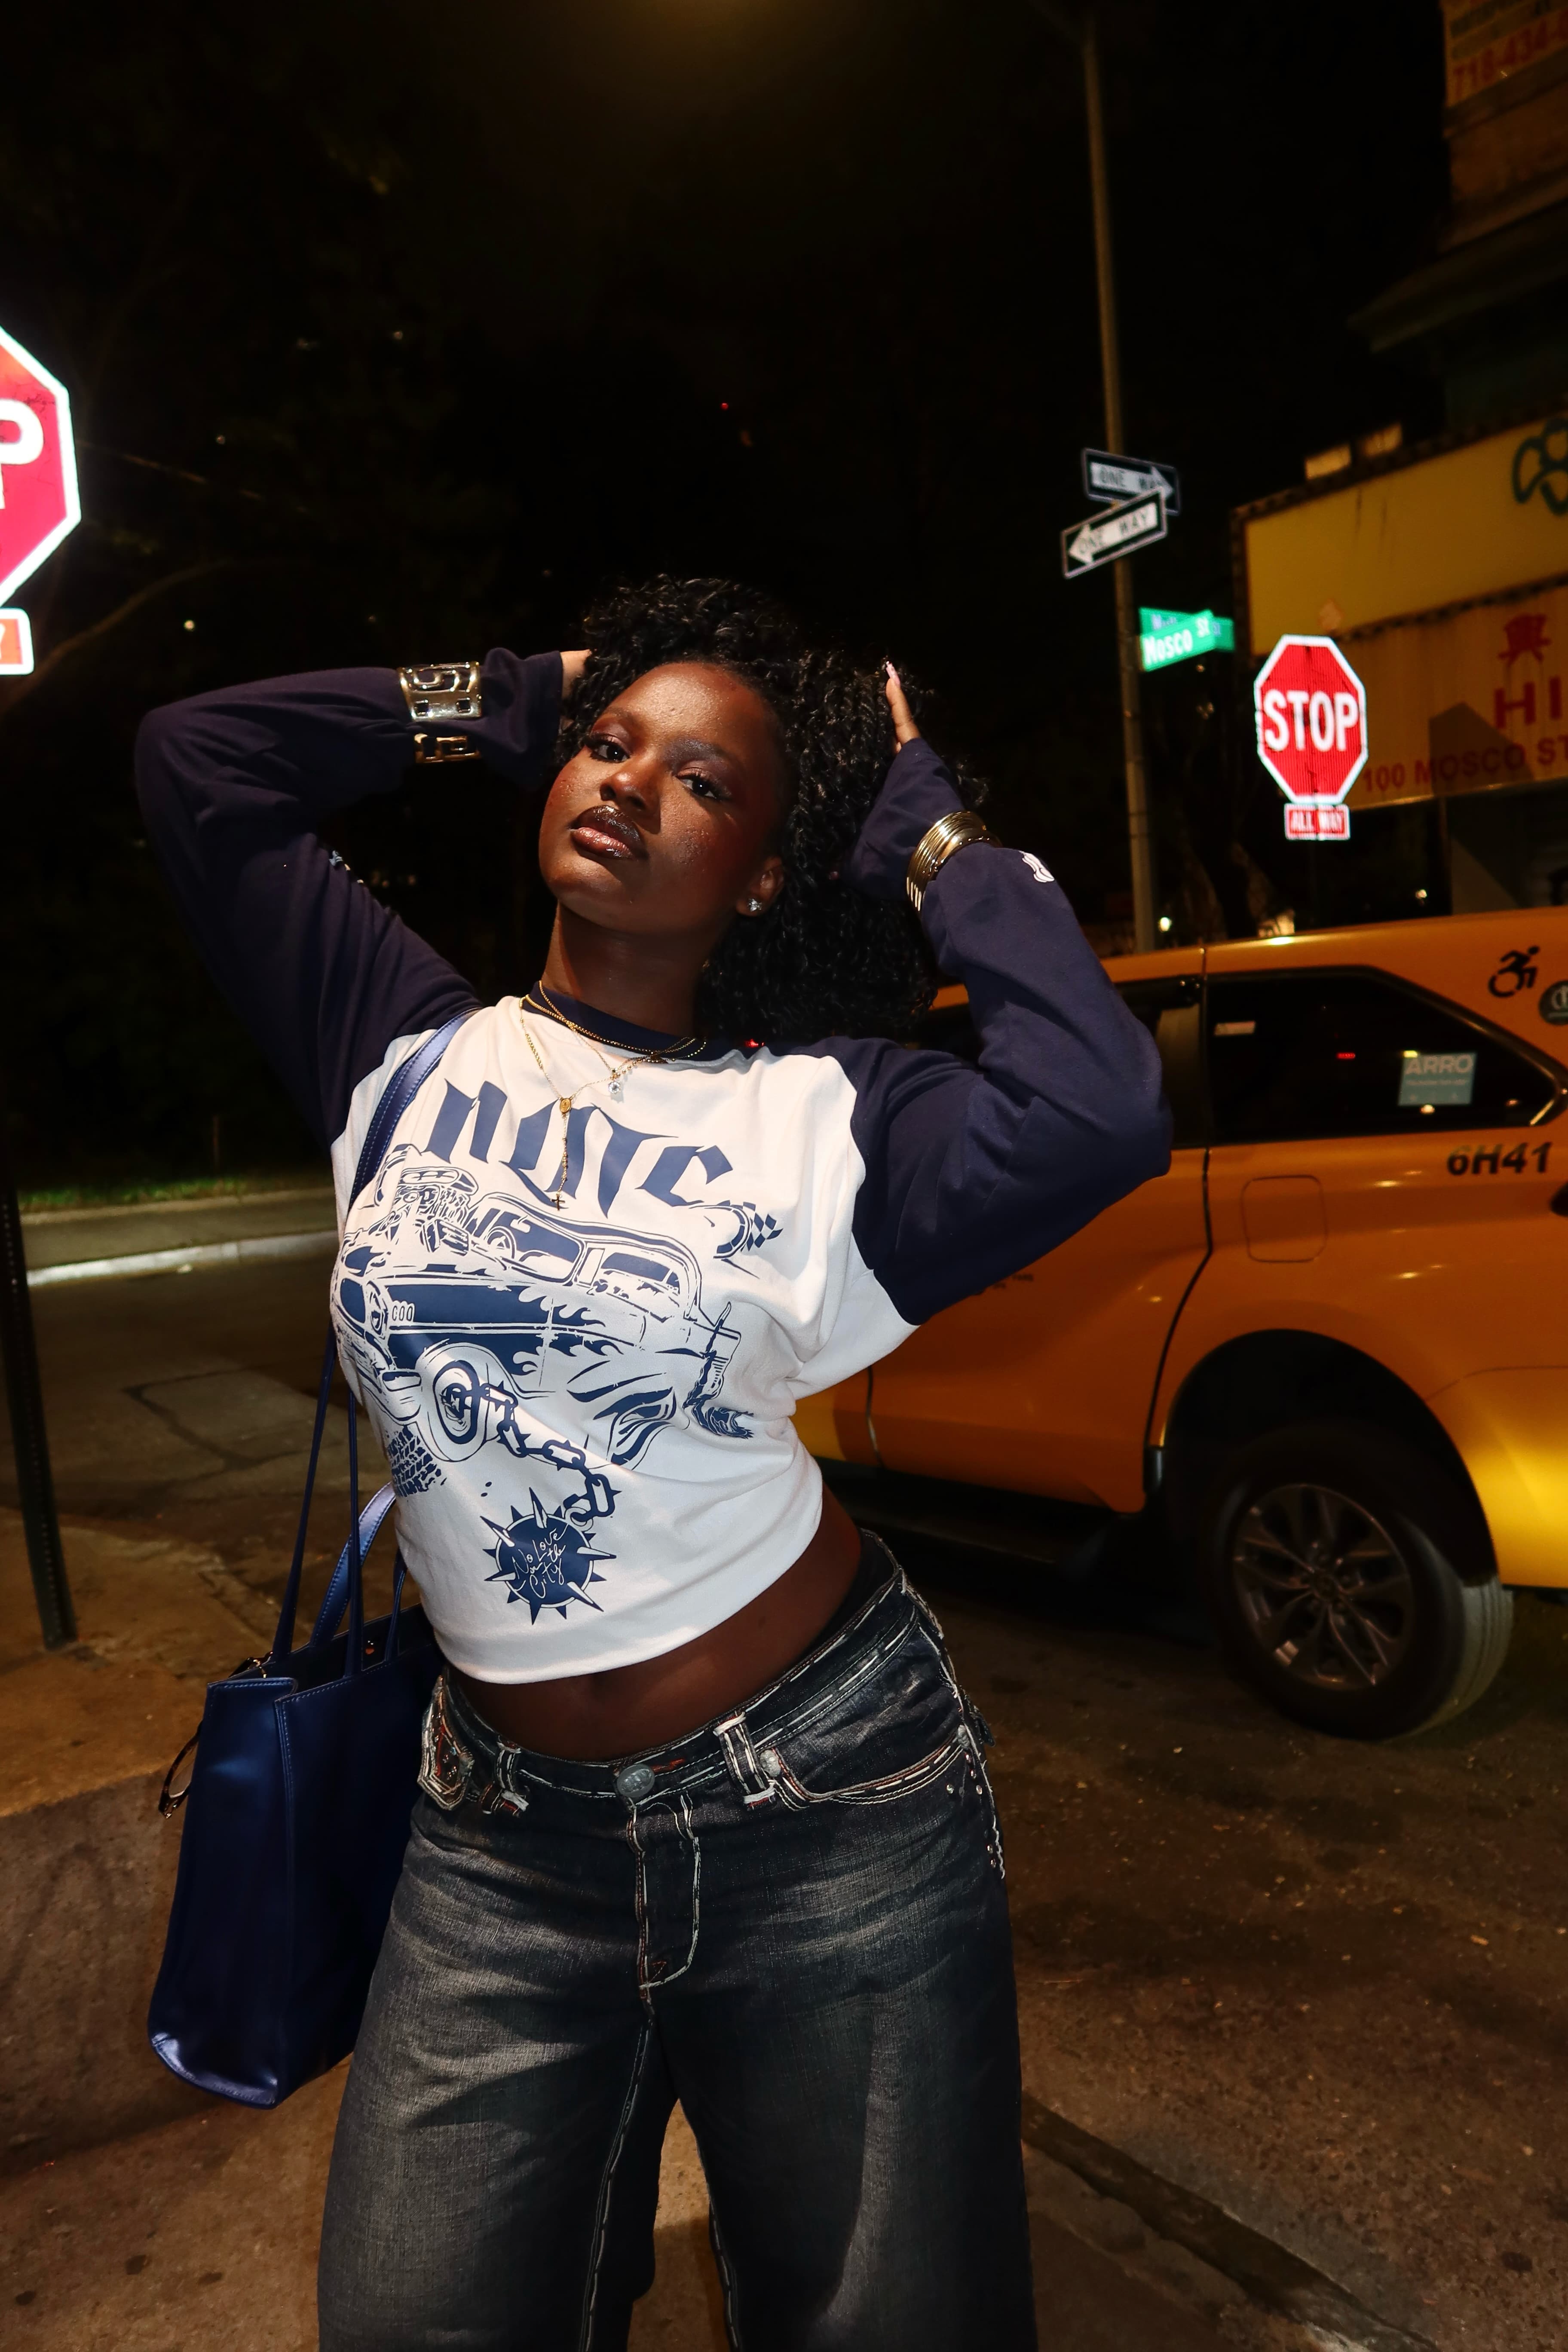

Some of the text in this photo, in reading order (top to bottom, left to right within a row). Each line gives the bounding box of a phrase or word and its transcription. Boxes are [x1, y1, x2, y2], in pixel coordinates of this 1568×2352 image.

[1099, 468, 1125, 487] ONE
[1079, 508, 1148, 554] ONE WAY
[1263, 689, 1358, 752] STOP
[1363, 764, 1405, 792] 100
[1415, 744, 1525, 784] MOSCO
[1291, 811, 1342, 831] ALL WAY
[1405, 1054, 1473, 1075] ARRO
[1447, 1142, 1553, 1176] 6H41
[512, 1524, 570, 1580] No Love
[547, 1544, 566, 1562] the
[530, 1558, 564, 1599] City
